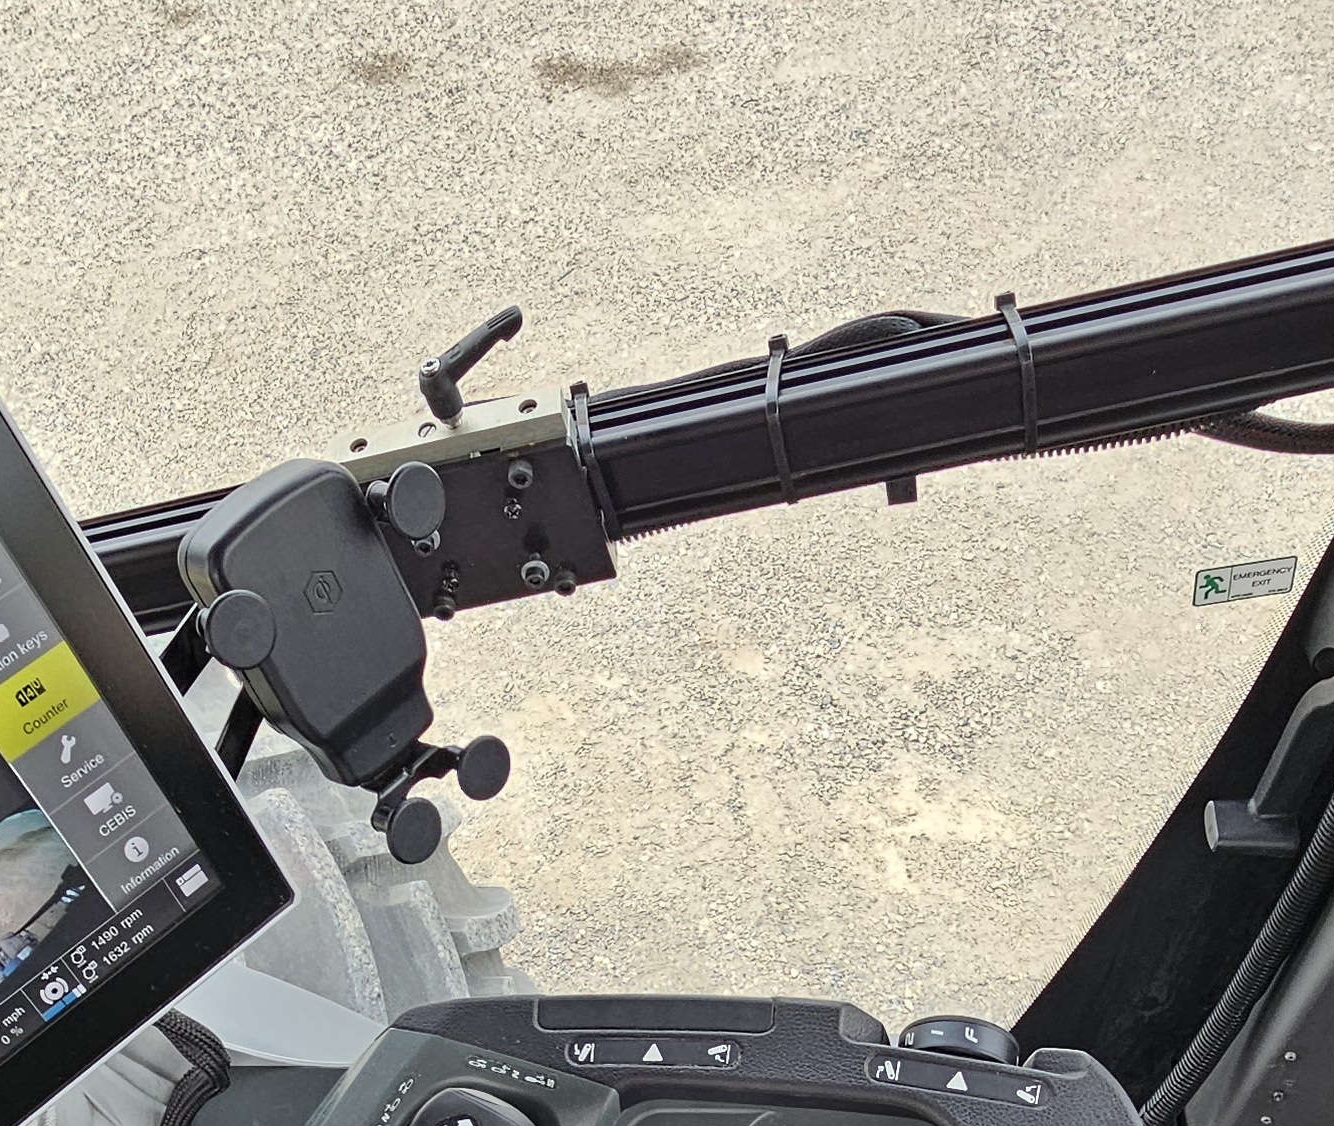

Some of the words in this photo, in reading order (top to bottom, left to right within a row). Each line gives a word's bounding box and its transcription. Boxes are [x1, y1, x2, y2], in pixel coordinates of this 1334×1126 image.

[1233, 566, 1293, 581] EMERGENCY
[1251, 578, 1272, 588] EXIT
[16, 629, 48, 656] keys
[22, 698, 70, 735] Counter
[61, 753, 105, 788] Service
[99, 805, 137, 838] CEBIS
[120, 846, 181, 895] Information
[90, 925, 119, 951] 1490
[119, 907, 144, 930] rpm
[101, 941, 131, 967] 1632
[130, 923, 155, 945] rpm
[1, 1005, 26, 1028] mph
[0, 1034, 11, 1046] 0
